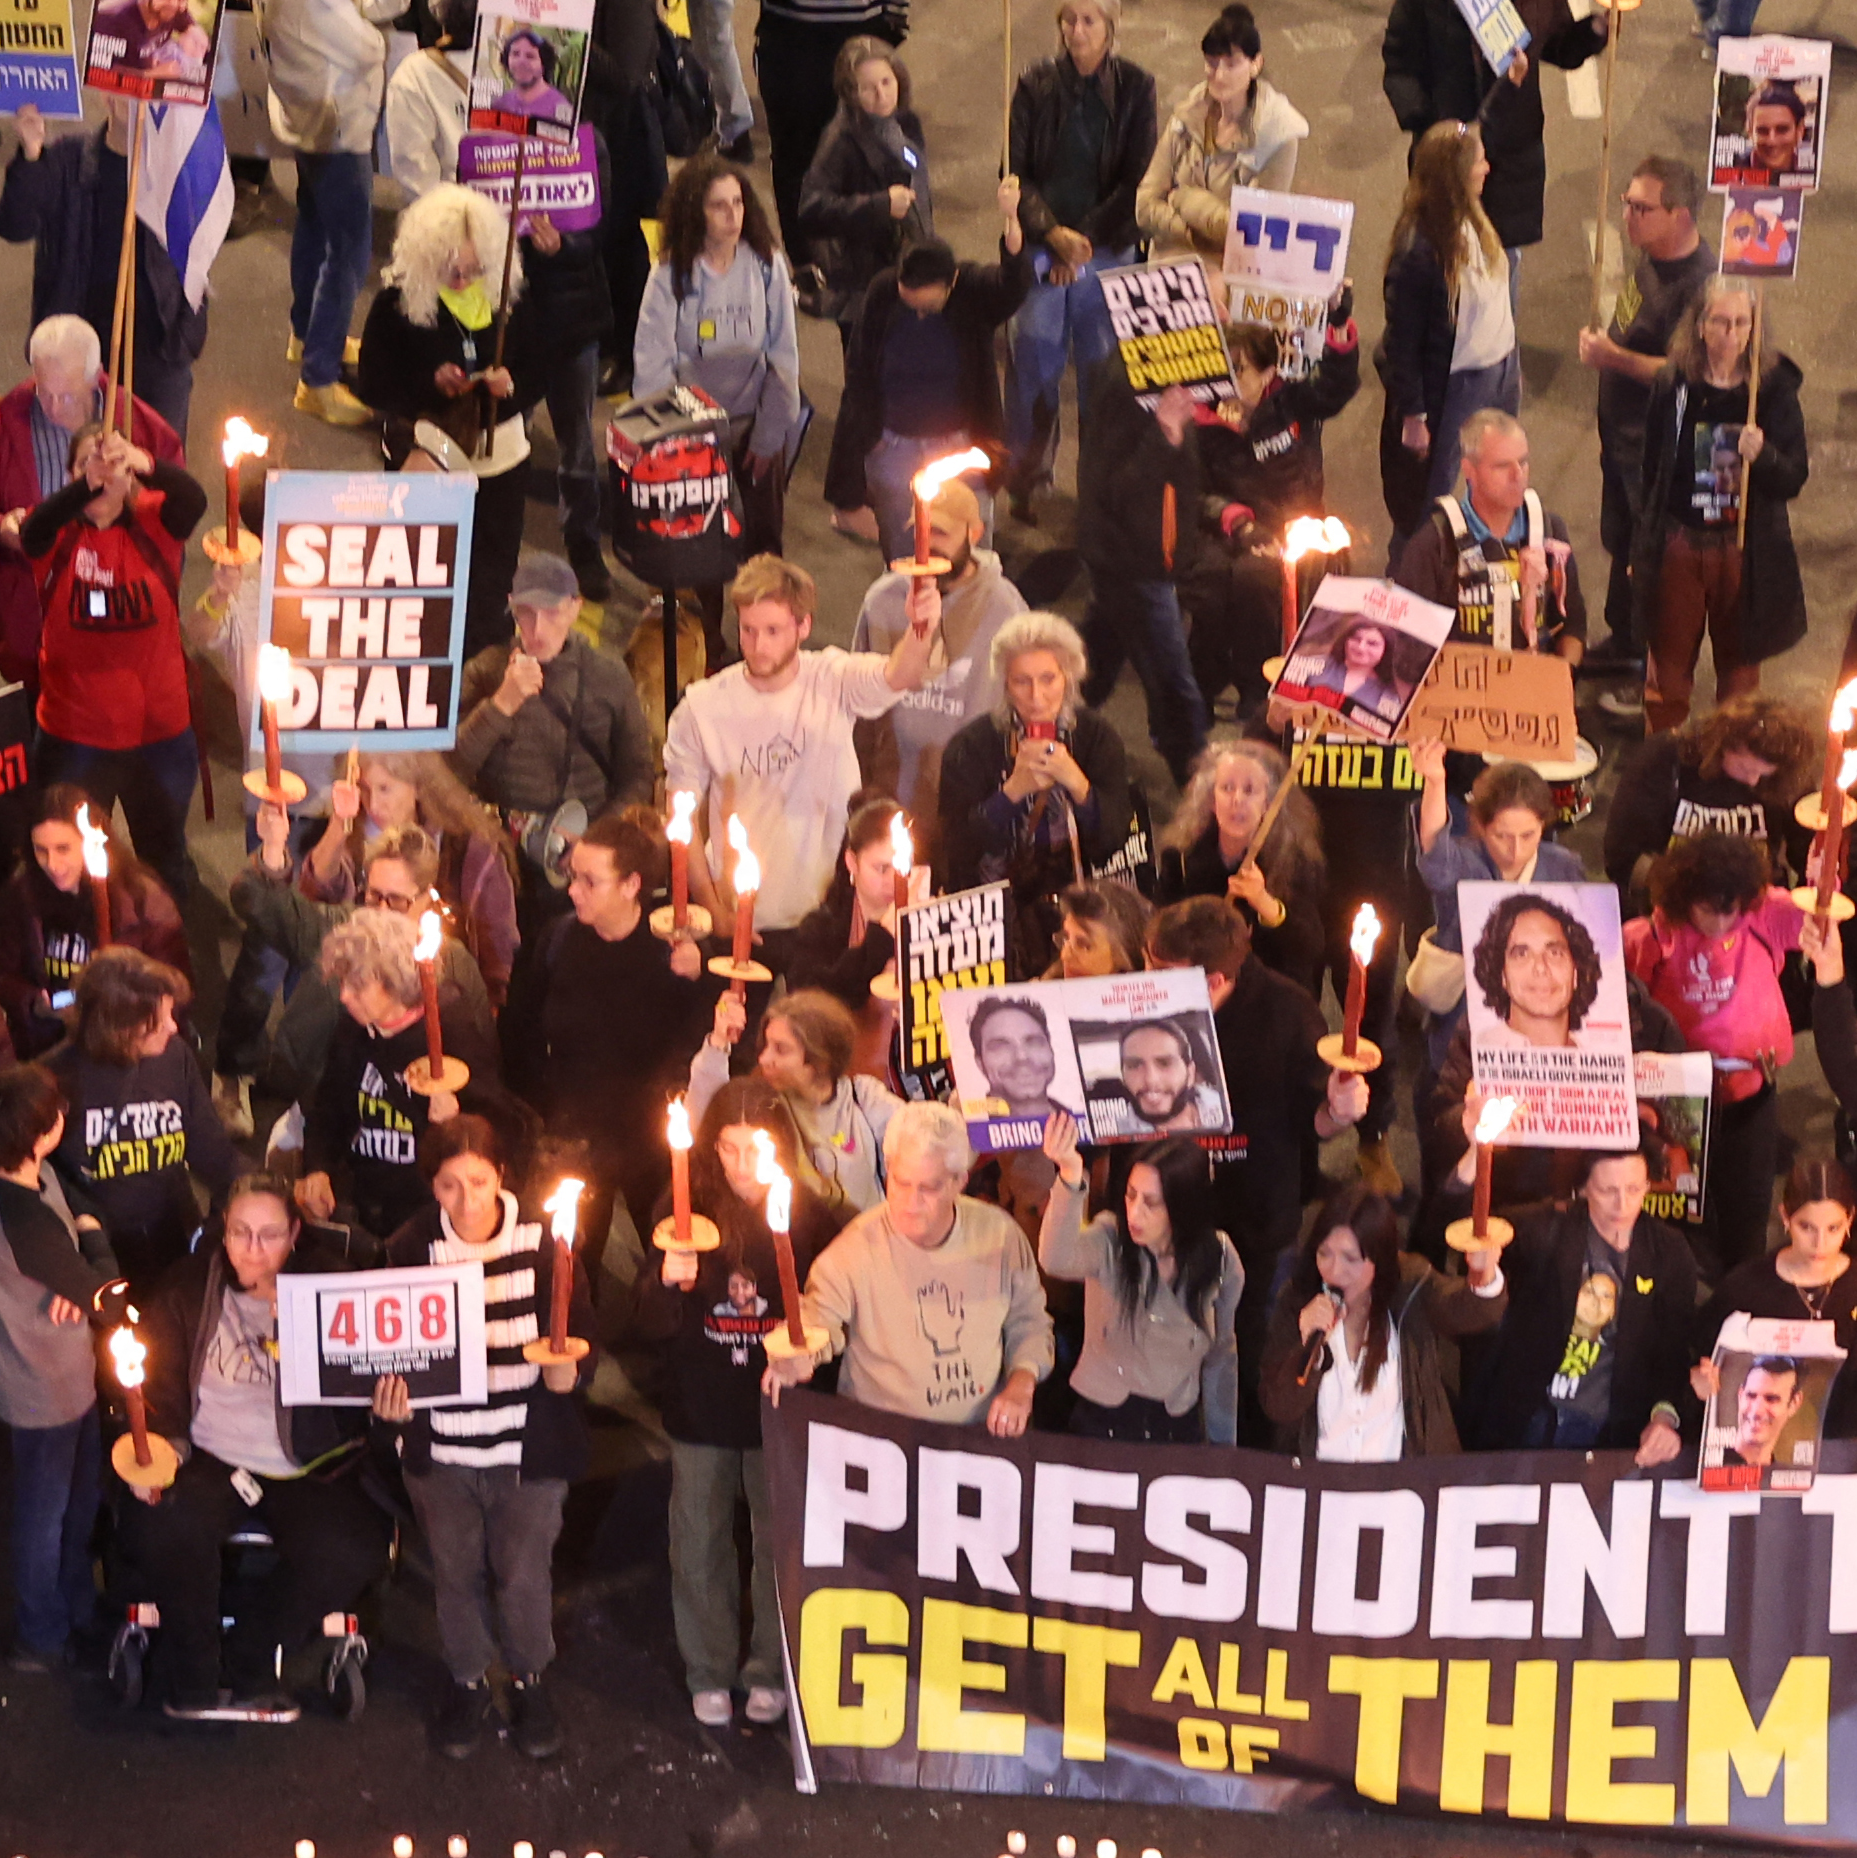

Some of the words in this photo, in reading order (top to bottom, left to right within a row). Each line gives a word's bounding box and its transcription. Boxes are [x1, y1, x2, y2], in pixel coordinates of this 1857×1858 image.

[282, 524, 449, 589] SEAL
[301, 596, 426, 660] THE
[901, 687, 965, 717] adidas
[907, 888, 1004, 943] תוציאו
[908, 924, 1005, 983] מעזה
[1478, 1052, 1497, 1065] MY
[1500, 1052, 1528, 1067] LIFE
[1550, 1054, 1575, 1068] THE
[1580, 1055, 1626, 1070] HANDS
[1545, 1071, 1626, 1085] GOVERNMENT
[1489, 1085, 1521, 1099] THEY
[1559, 1087, 1585, 1100] SIGN
[1597, 1088, 1627, 1101] DEAL
[1552, 1102, 1605, 1117] SIGNING
[1608, 1103, 1628, 1118] MY
[989, 1121, 1044, 1149] BRING
[1541, 1120, 1632, 1137] WARRANT!
[329, 1293, 448, 1347] 468
[802, 1425, 1762, 1640] PRESIDENT
[797, 1585, 1143, 1763] GET
[1152, 1634, 1311, 1724] ALL
[1178, 1714, 1280, 1773] OF
[1327, 1652, 1831, 1829] THEM
